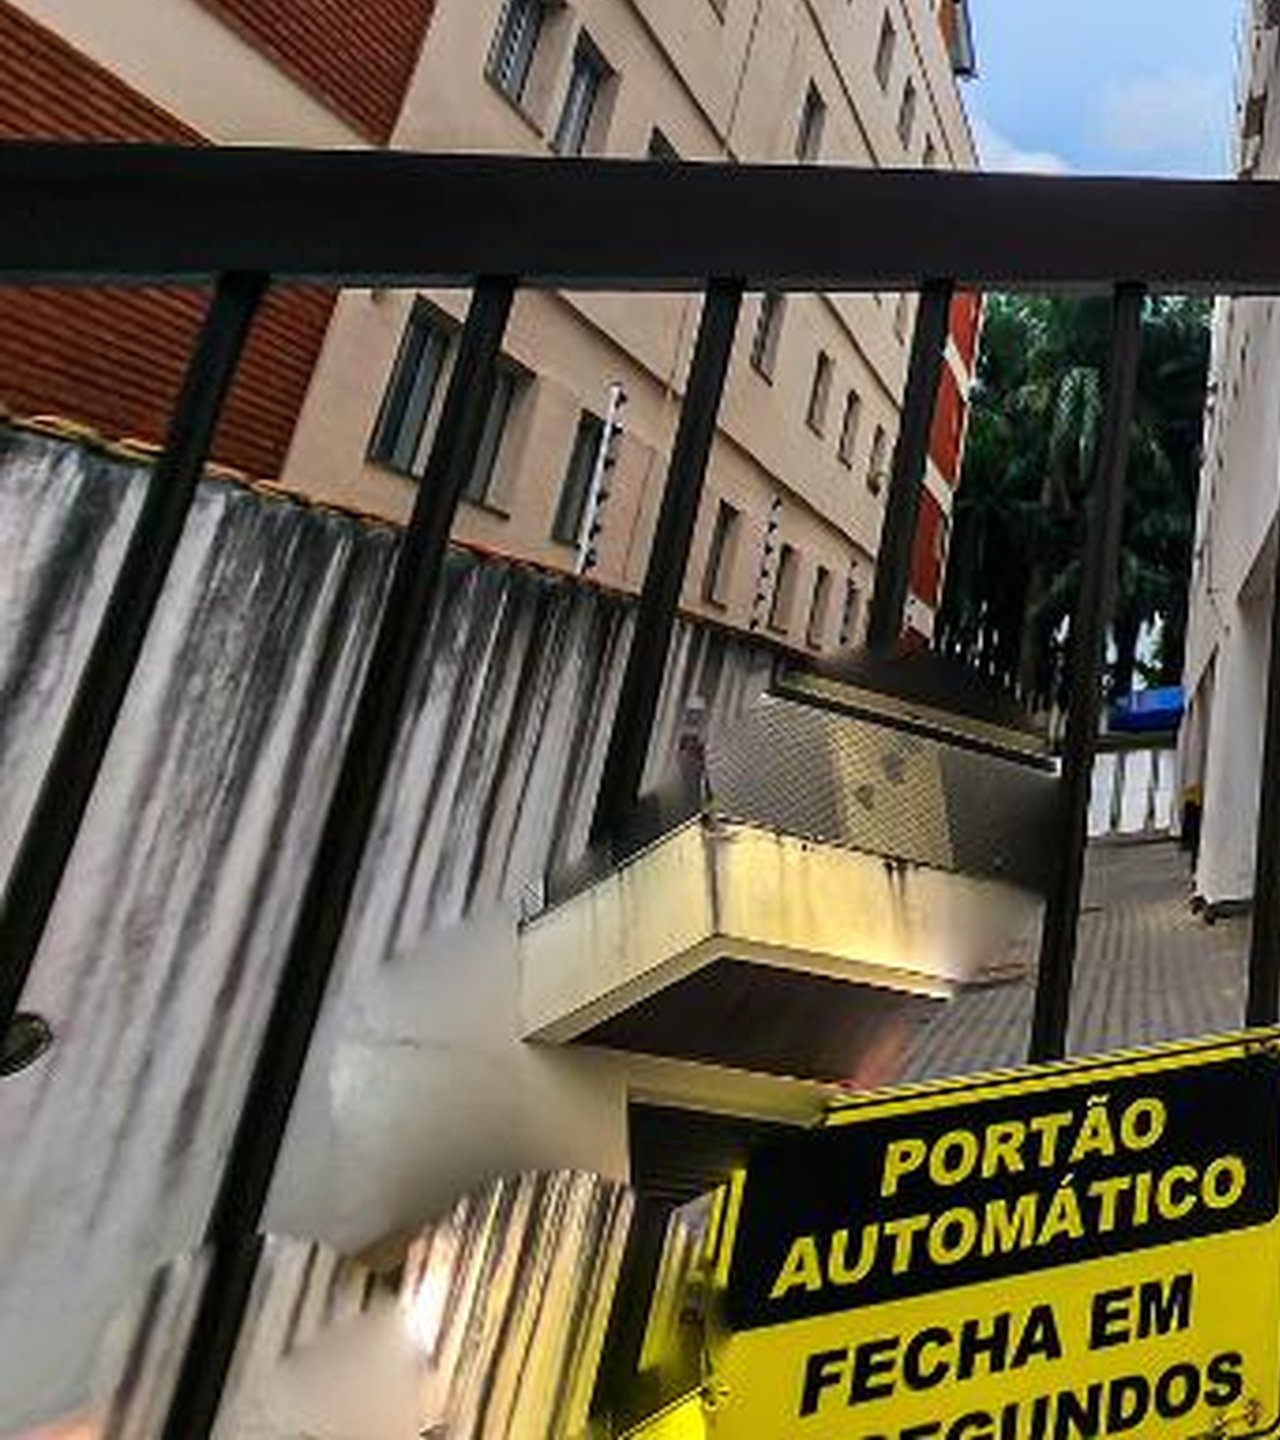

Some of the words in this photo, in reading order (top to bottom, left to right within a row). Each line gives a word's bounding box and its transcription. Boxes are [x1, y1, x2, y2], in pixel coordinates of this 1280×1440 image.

[880, 1095, 1167, 1197] PORTÃO
[769, 1155, 1247, 1299] AUTOMÁTICO
[799, 1303, 1063, 1417] FECHA
[1088, 1272, 1194, 1350] EM
[863, 1351, 1243, 1440] GUNDOS
